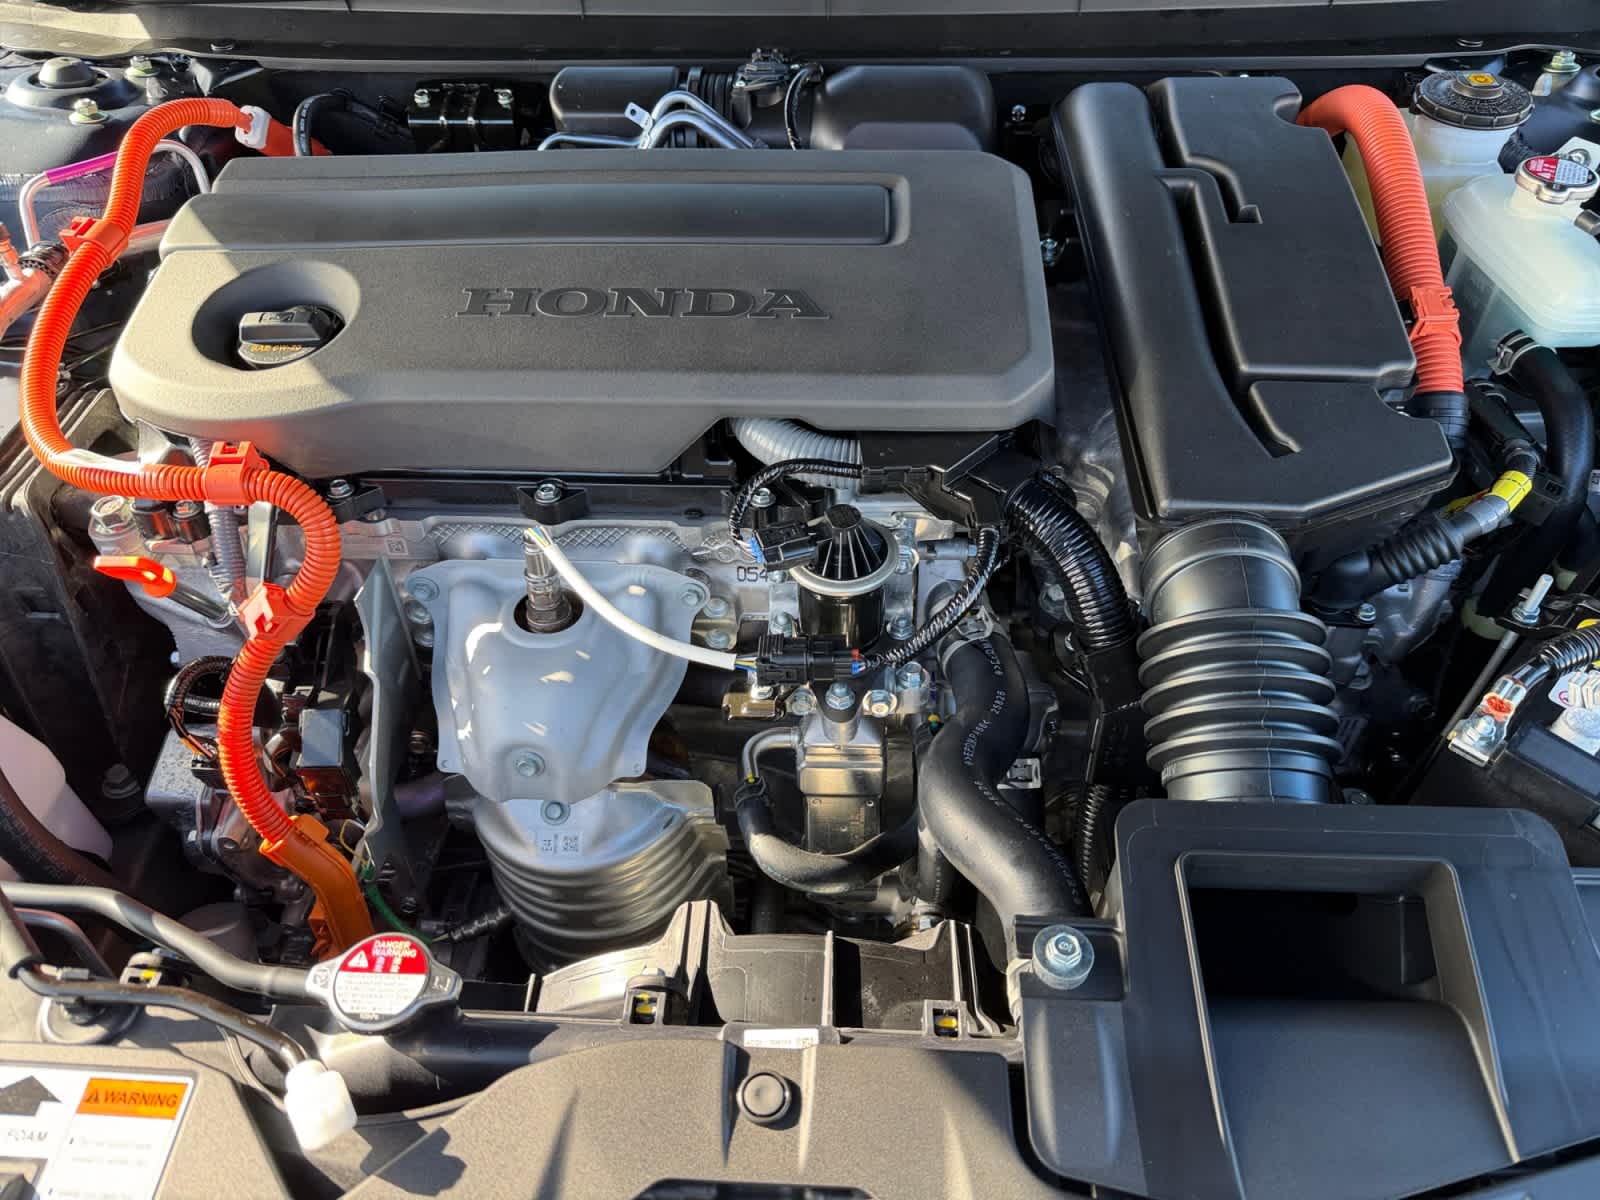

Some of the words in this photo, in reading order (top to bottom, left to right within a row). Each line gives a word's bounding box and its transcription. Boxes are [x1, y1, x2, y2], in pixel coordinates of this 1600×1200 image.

[455, 287, 831, 319] HONDA
[736, 565, 768, 582] 054
[372, 948, 417, 958] WARNING
[374, 940, 411, 951] DANGER
[104, 1089, 178, 1108] WARNING
